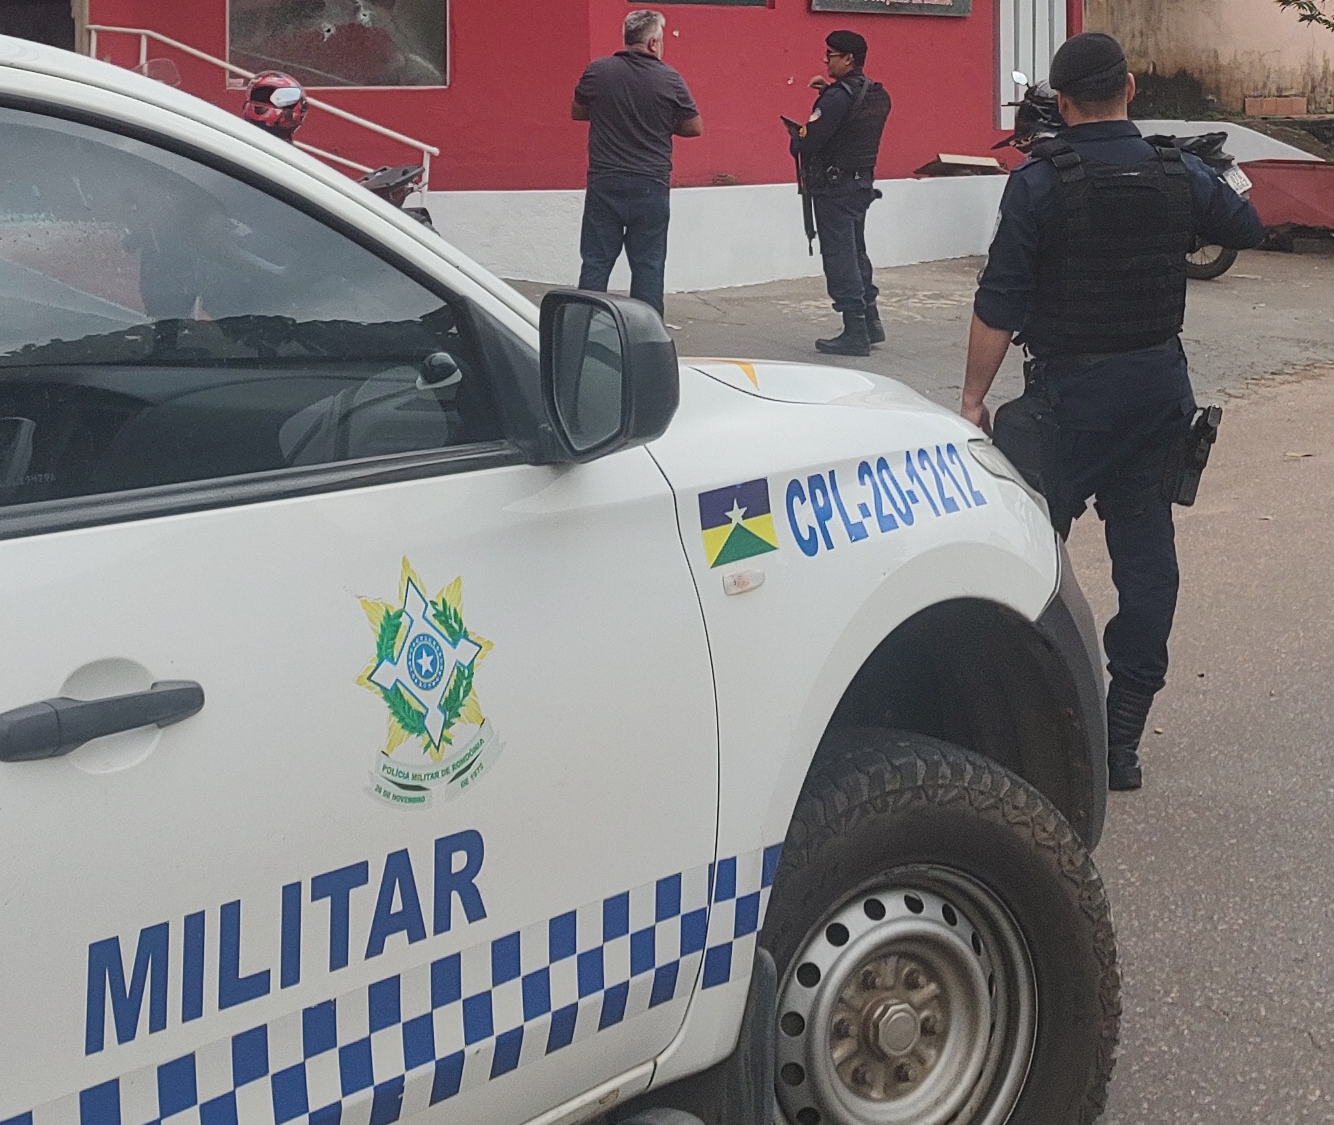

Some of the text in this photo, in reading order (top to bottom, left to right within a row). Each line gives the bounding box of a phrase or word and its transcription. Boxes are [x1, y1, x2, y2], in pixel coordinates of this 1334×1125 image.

[785, 442, 988, 558] CPL-20-1212
[410, 771, 440, 781] MILITAR
[441, 766, 451, 777] DE
[85, 829, 488, 1056] MILITAR
